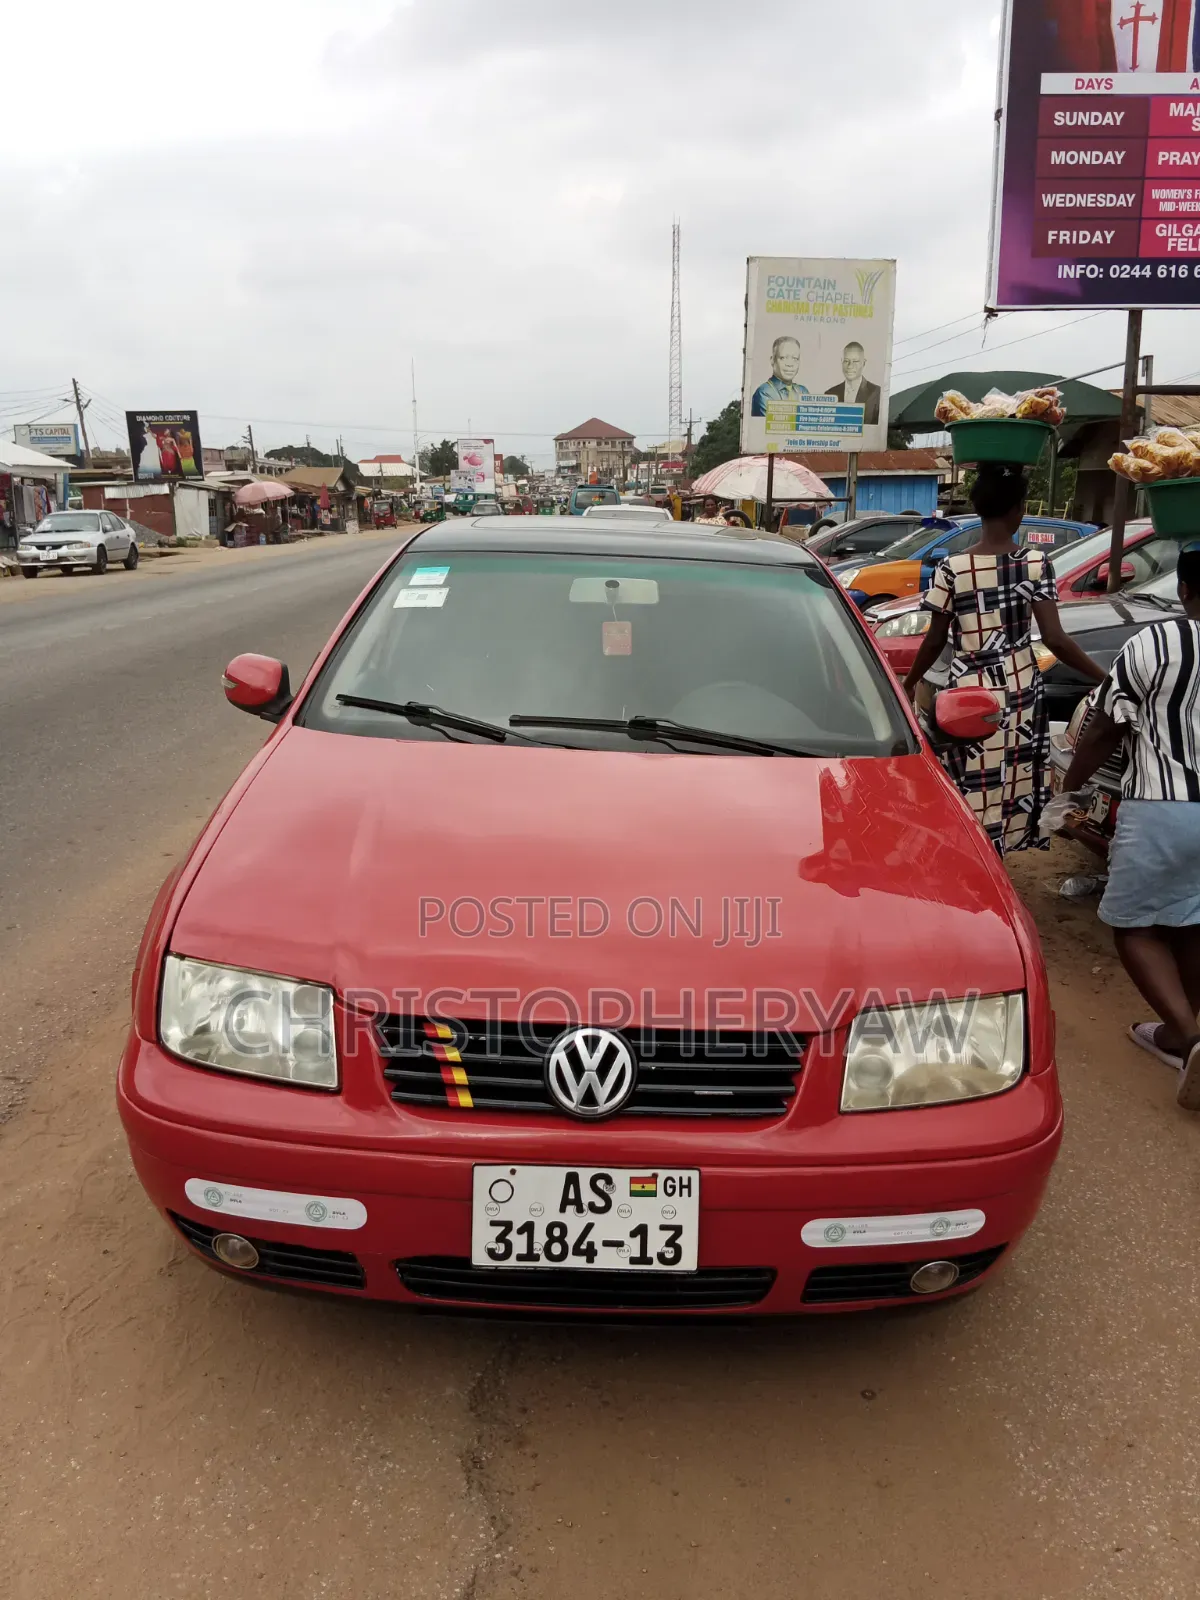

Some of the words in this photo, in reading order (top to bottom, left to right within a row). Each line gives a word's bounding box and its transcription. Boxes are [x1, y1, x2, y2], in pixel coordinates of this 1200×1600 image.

[1074, 78, 1113, 90] DAYS
[1053, 111, 1125, 126] SUNDAY
[1050, 150, 1126, 165] MONDAY
[1042, 193, 1136, 208] WEDNESDAY
[1151, 189, 1192, 200] WOMEN'S
[1047, 230, 1115, 245] FRIDAY
[1167, 238, 1200, 251] FEL
[1057, 264, 1104, 279] INFO:
[1109, 264, 1152, 279] 0244
[1157, 264, 1188, 279] 616
[767, 275, 837, 290] FOUNTAIN
[766, 288, 801, 300] GATE
[806, 291, 857, 304] CHAPEL
[813, 302, 831, 316] CITY
[1028, 533, 1039, 542] FOR
[1040, 534, 1054, 543] SALE
[559, 1171, 614, 1214] AS
[663, 1175, 692, 1198] GH
[486, 1220, 683, 1266] 3184-13
